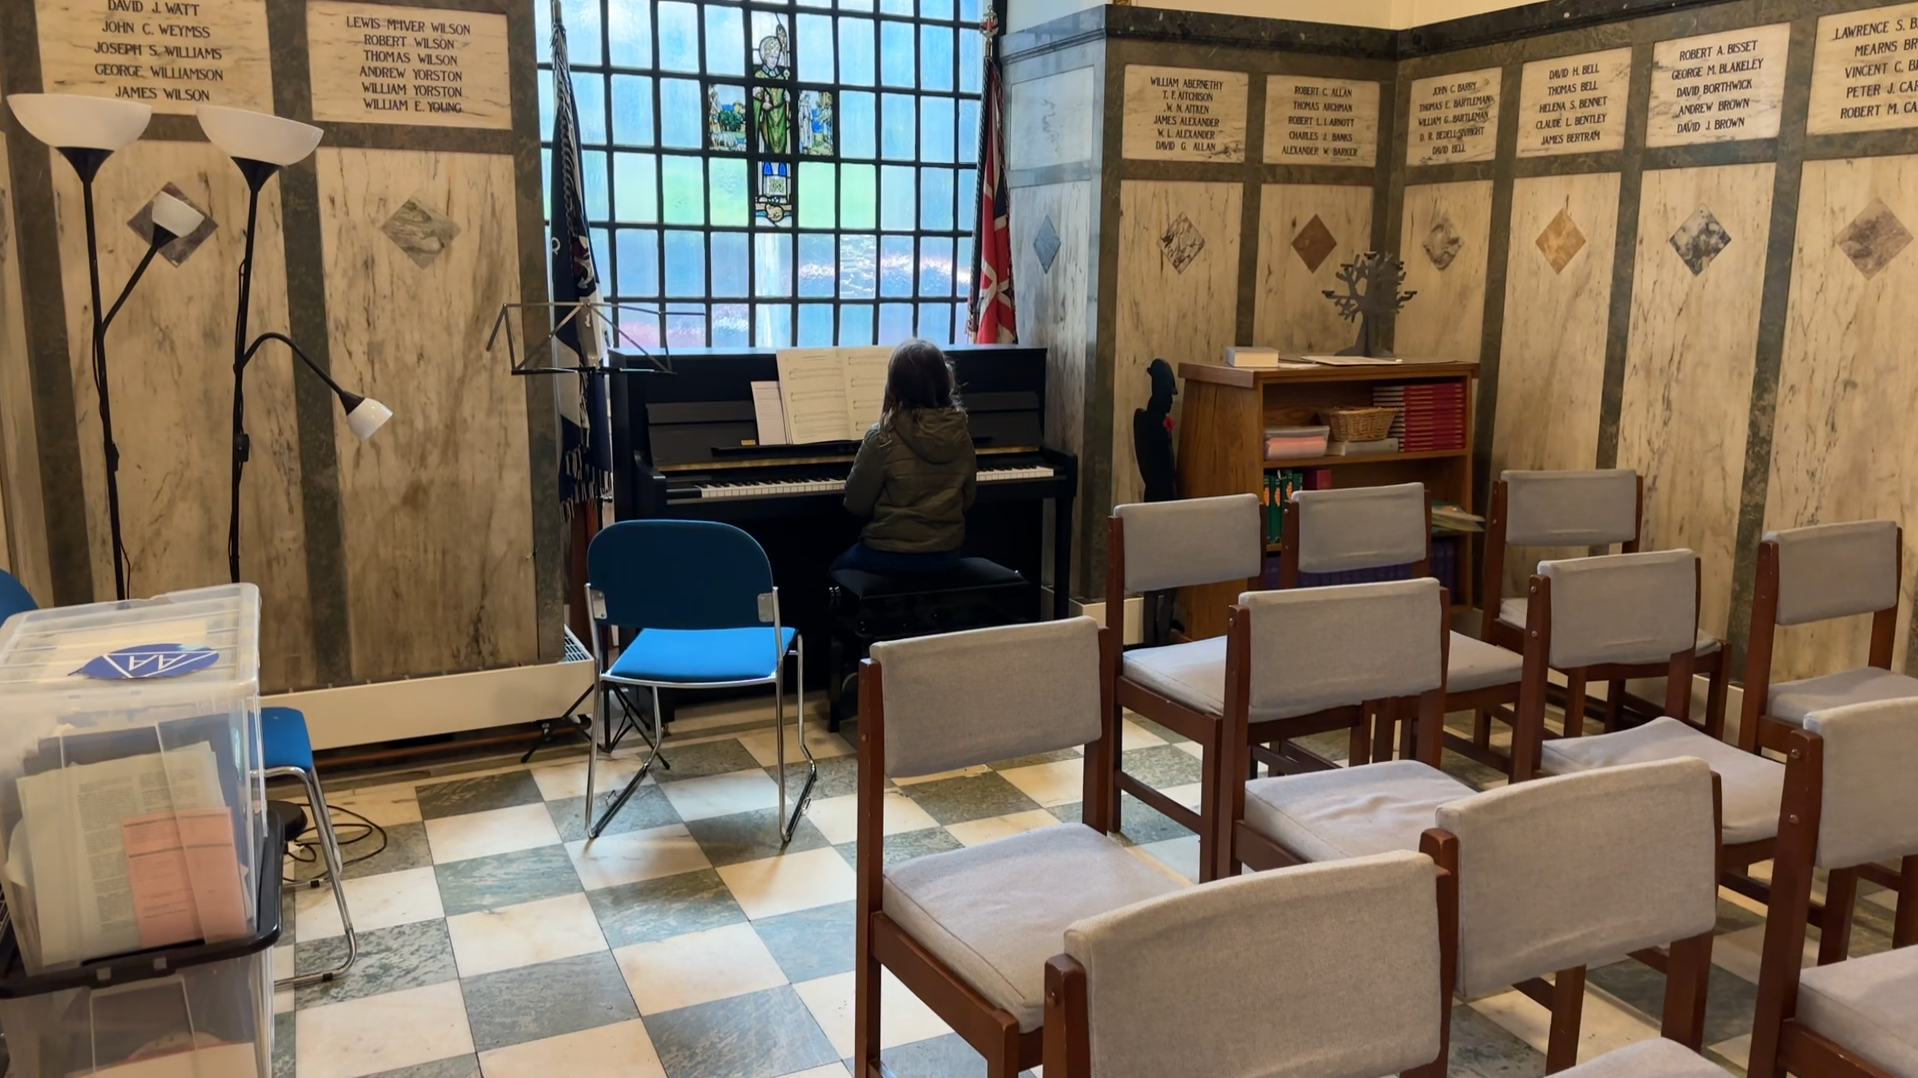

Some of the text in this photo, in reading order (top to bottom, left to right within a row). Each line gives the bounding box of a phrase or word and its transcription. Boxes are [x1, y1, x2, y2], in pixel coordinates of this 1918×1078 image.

[109, 0, 199, 16] DAVID J. WATT
[102, 21, 210, 38] JOHN C. WEYMSS
[347, 16, 380, 29] LEWIS
[431, 22, 470, 35] WILSON
[1835, 17, 1918, 40] LAWRENCE S. B
[364, 34, 454, 49] ROBERT WILSON
[1855, 38, 1918, 57] MEARNS BR
[94, 42, 222, 60] JOSEPH S. WILLIAMS
[363, 50, 457, 66] THOMAS WILSON
[1680, 40, 1758, 61] ROBERT A. BISSET
[95, 64, 223, 81] GEORGE WILLIAMSON
[360, 66, 462, 82] ANDREW YORSTON
[1549, 68, 1569, 79] DAVID
[1582, 63, 1599, 75] BELL
[1672, 58, 1764, 80] GEORGE M. BLAKELEY
[1845, 59, 1918, 78] VINCENT C. B
[116, 86, 210, 101] JAMES WILSON
[362, 82, 462, 97] WILLIAM YORSTON
[1548, 81, 1598, 96] THOMAS BELL
[1677, 79, 1752, 98] DAVID BORTHWICK
[1847, 84, 1881, 98] PETER
[1887, 83, 1894, 94] J.
[363, 98, 461, 113] WILLIAM E. YOUNG
[1539, 102, 1566, 113] HELENA
[1579, 96, 1607, 109] BENNET
[1678, 98, 1749, 115] ANDREW BROWN
[1840, 104, 1881, 119] ROBERT
[1887, 103, 1899, 115] M.
[1536, 118, 1562, 130] CLAUDE
[1575, 113, 1607, 126] BENTLEY
[1677, 122, 1700, 133] DAVID
[1714, 117, 1745, 130] BROWN
[1541, 130, 1600, 145] JAMES BERTRAM
